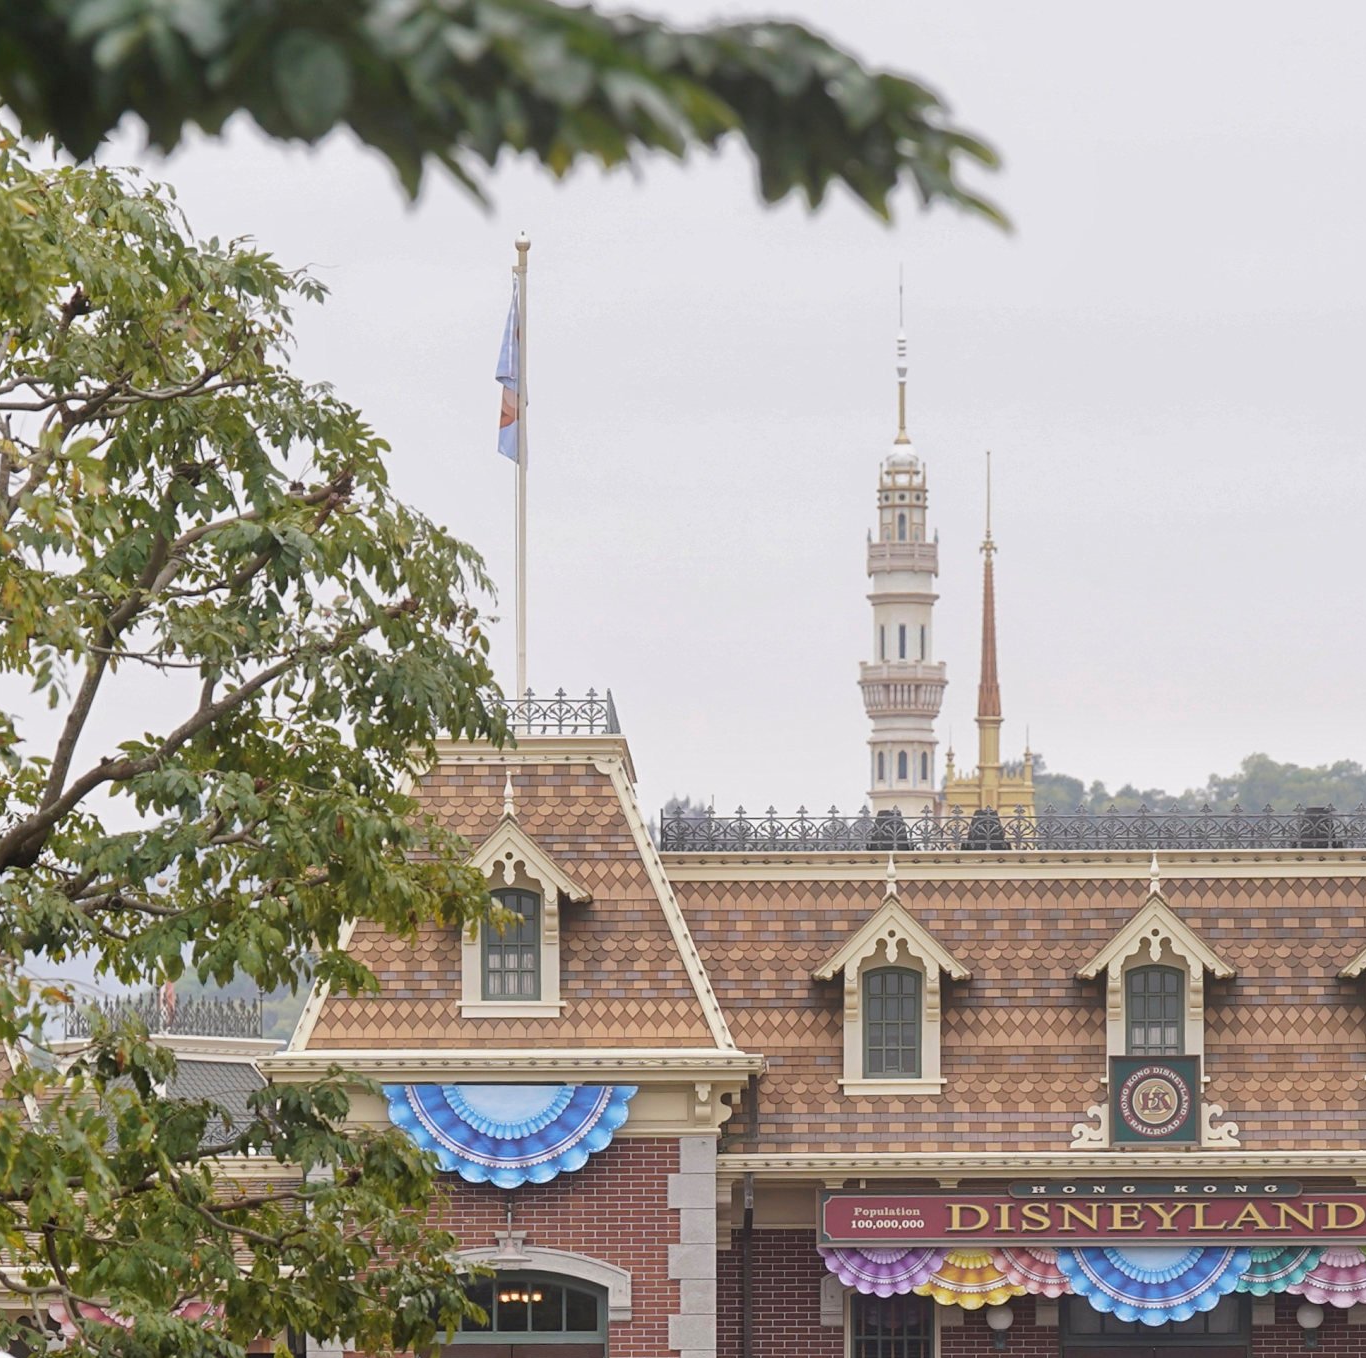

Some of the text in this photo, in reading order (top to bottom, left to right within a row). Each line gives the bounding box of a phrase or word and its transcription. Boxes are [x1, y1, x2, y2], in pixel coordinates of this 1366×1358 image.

[1120, 1067, 1189, 1117] HONG KONG DISNEYLAND
[1129, 1119, 1180, 1135] RAILROAD
[1031, 1184, 1279, 1194] HONG KONG
[854, 1207, 921, 1218] Population
[945, 1202, 1366, 1233] DISNEYLAND
[851, 1219, 925, 1230] 100,000,000
